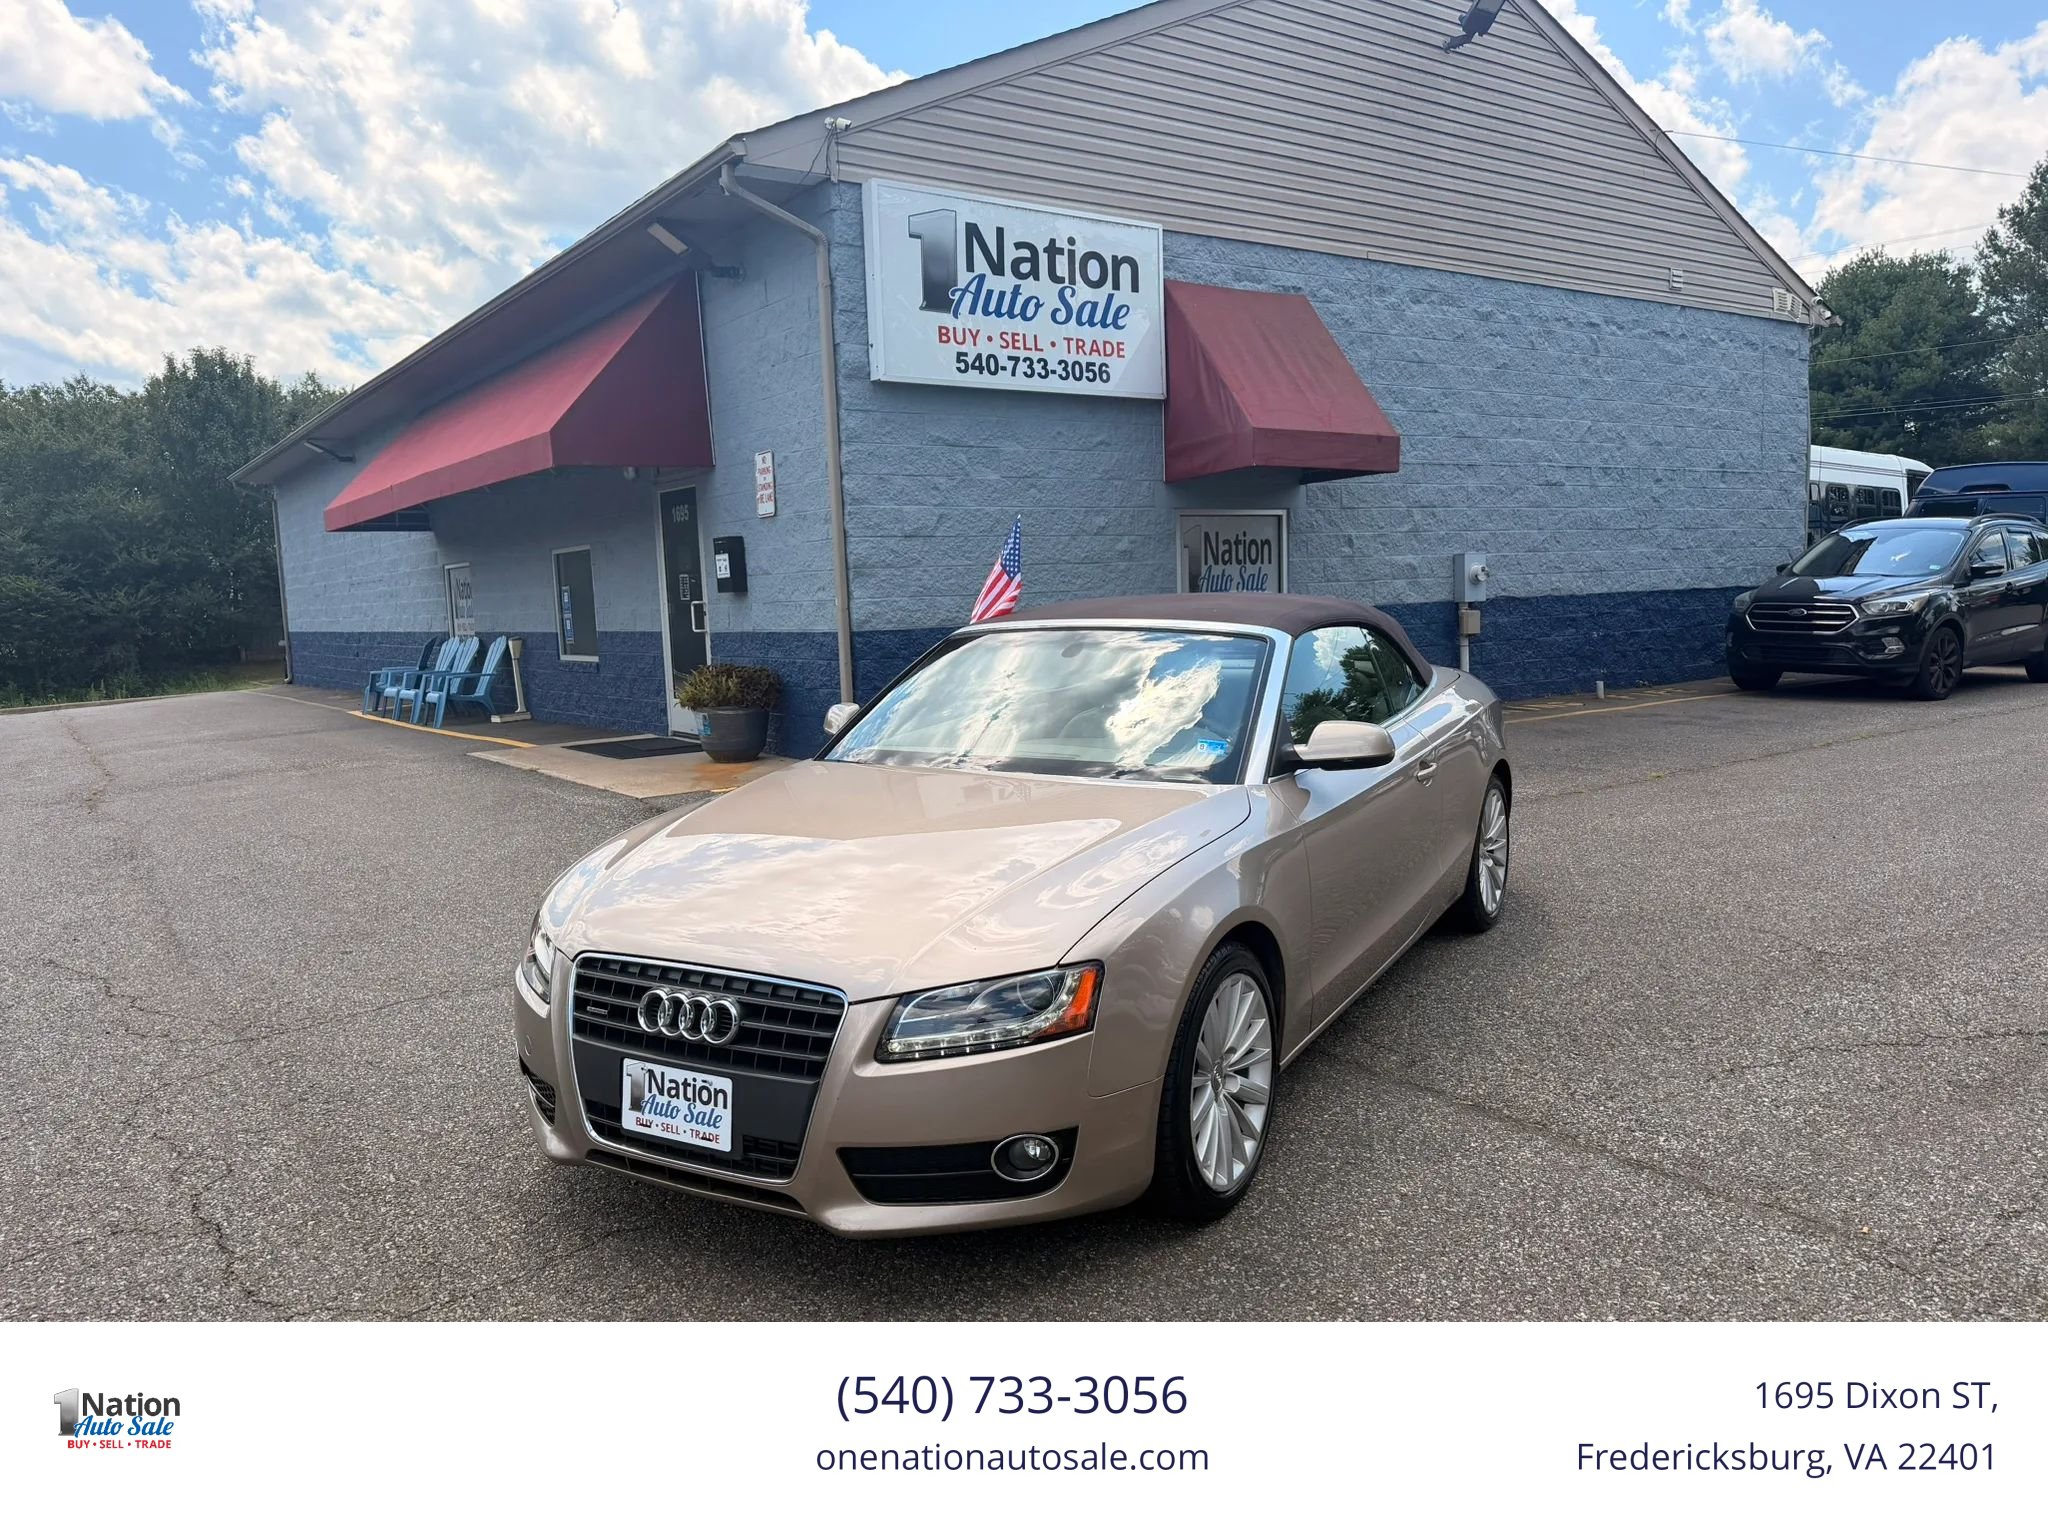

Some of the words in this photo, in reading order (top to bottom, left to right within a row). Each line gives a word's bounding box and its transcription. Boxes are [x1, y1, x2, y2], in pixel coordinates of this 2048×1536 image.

[964, 222, 1139, 292] Nation
[949, 273, 1044, 322] Auto
[1050, 286, 1130, 330] Sale
[937, 325, 980, 347] BUY
[999, 331, 1044, 352] SELL
[1063, 337, 1126, 358] TRADE
[955, 352, 1111, 383] 540-733-3056
[672, 504, 690, 523] 1695
[1203, 531, 1272, 566] Nation
[1200, 564, 1233, 593] Auto
[1236, 565, 1268, 592] Sale
[647, 1068, 728, 1109] Nation
[640, 1094, 681, 1119] Auto
[683, 1102, 722, 1129] Sale
[635, 1116, 654, 1129] BUY
[660, 1122, 681, 1135] SELL
[689, 1128, 721, 1144] TRADE
